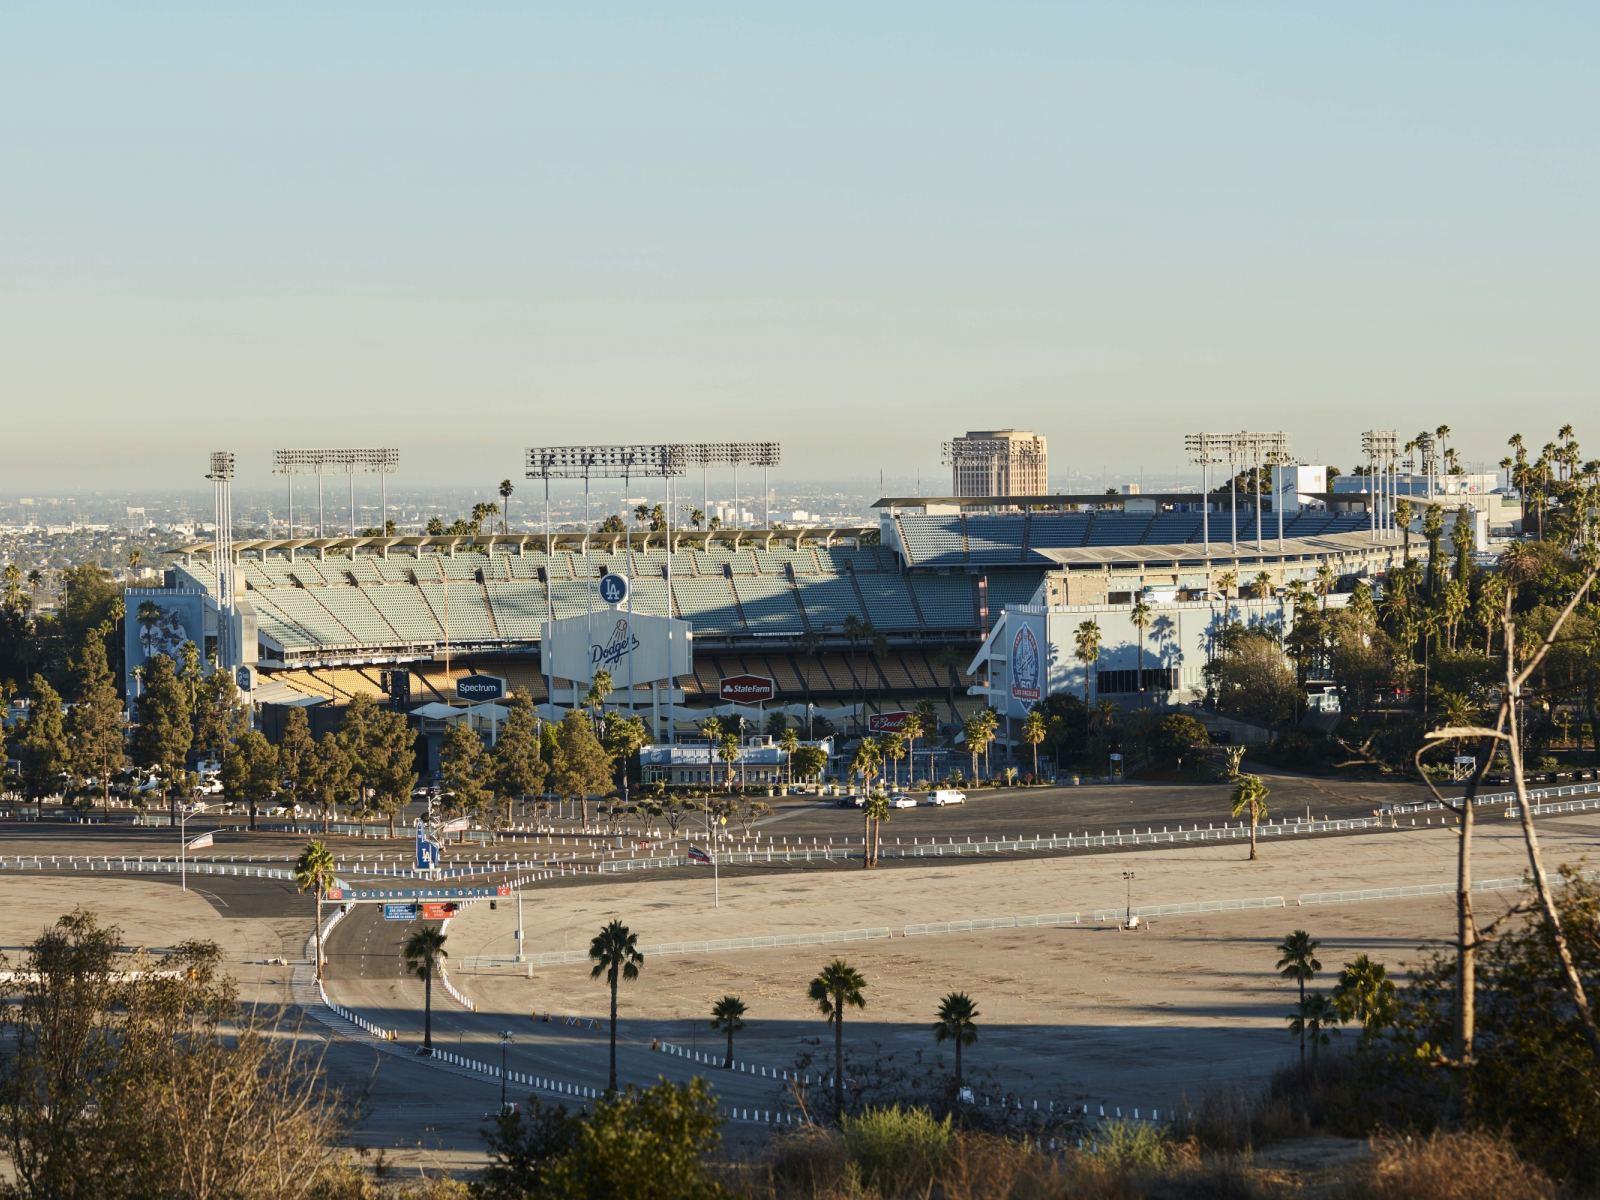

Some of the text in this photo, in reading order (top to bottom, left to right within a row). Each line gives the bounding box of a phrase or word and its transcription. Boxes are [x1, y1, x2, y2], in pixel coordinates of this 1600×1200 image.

[606, 578, 620, 600] LA
[460, 683, 496, 694] Spectrum
[422, 848, 431, 862] LA
[411, 889, 450, 897] STATE
[458, 888, 489, 897] GATE
